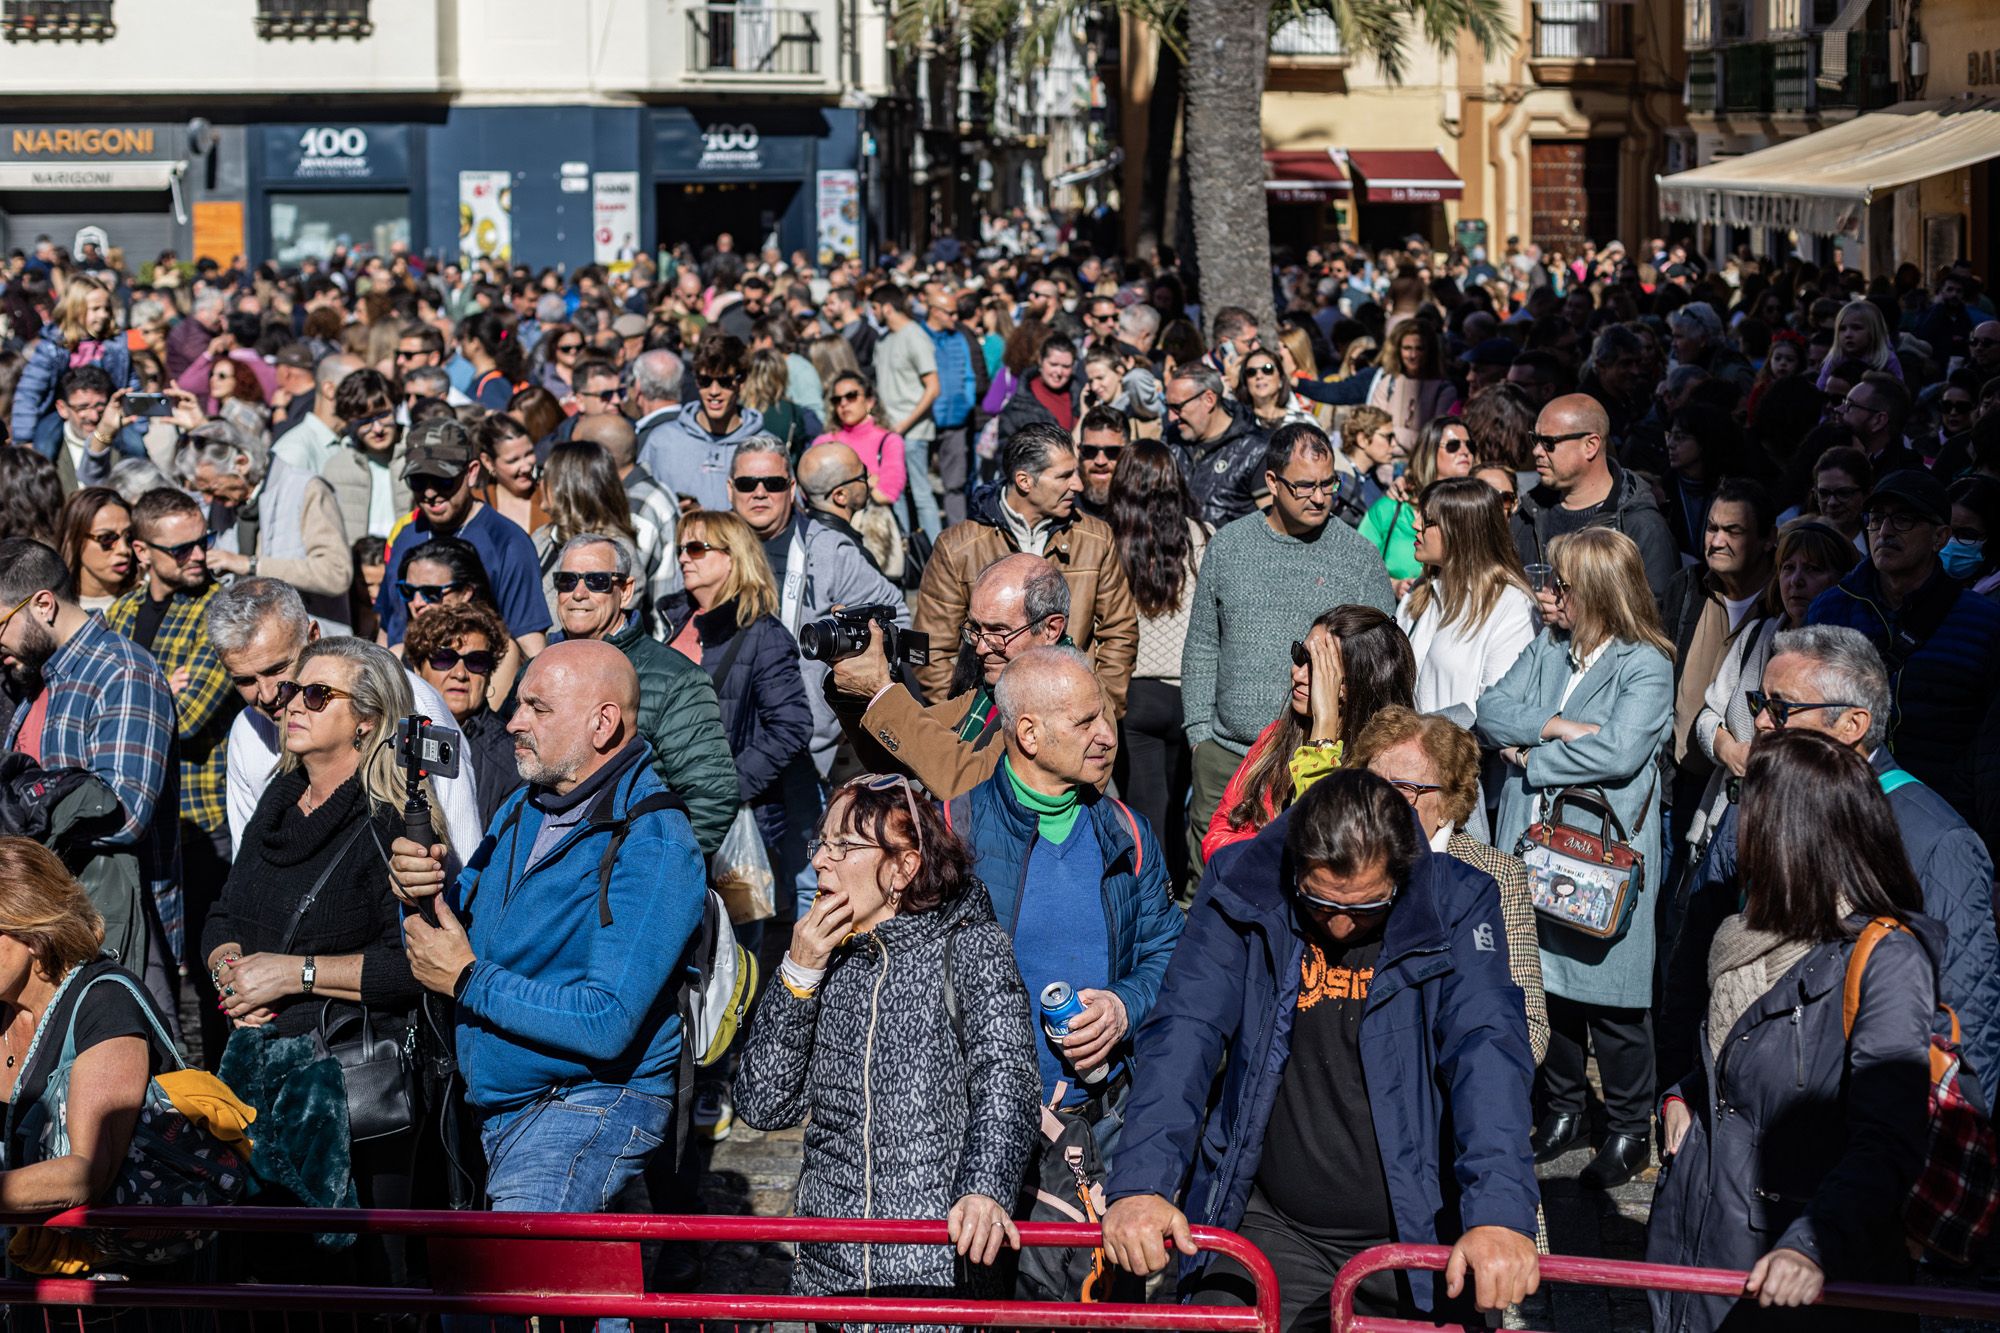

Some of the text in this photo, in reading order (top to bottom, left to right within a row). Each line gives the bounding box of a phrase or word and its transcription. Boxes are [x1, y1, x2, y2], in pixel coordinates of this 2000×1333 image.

[12, 128, 155, 155] NARIGONI
[299, 127, 368, 157] 100
[701, 123, 760, 151] 100
[32, 172, 114, 185] NARIGONI
